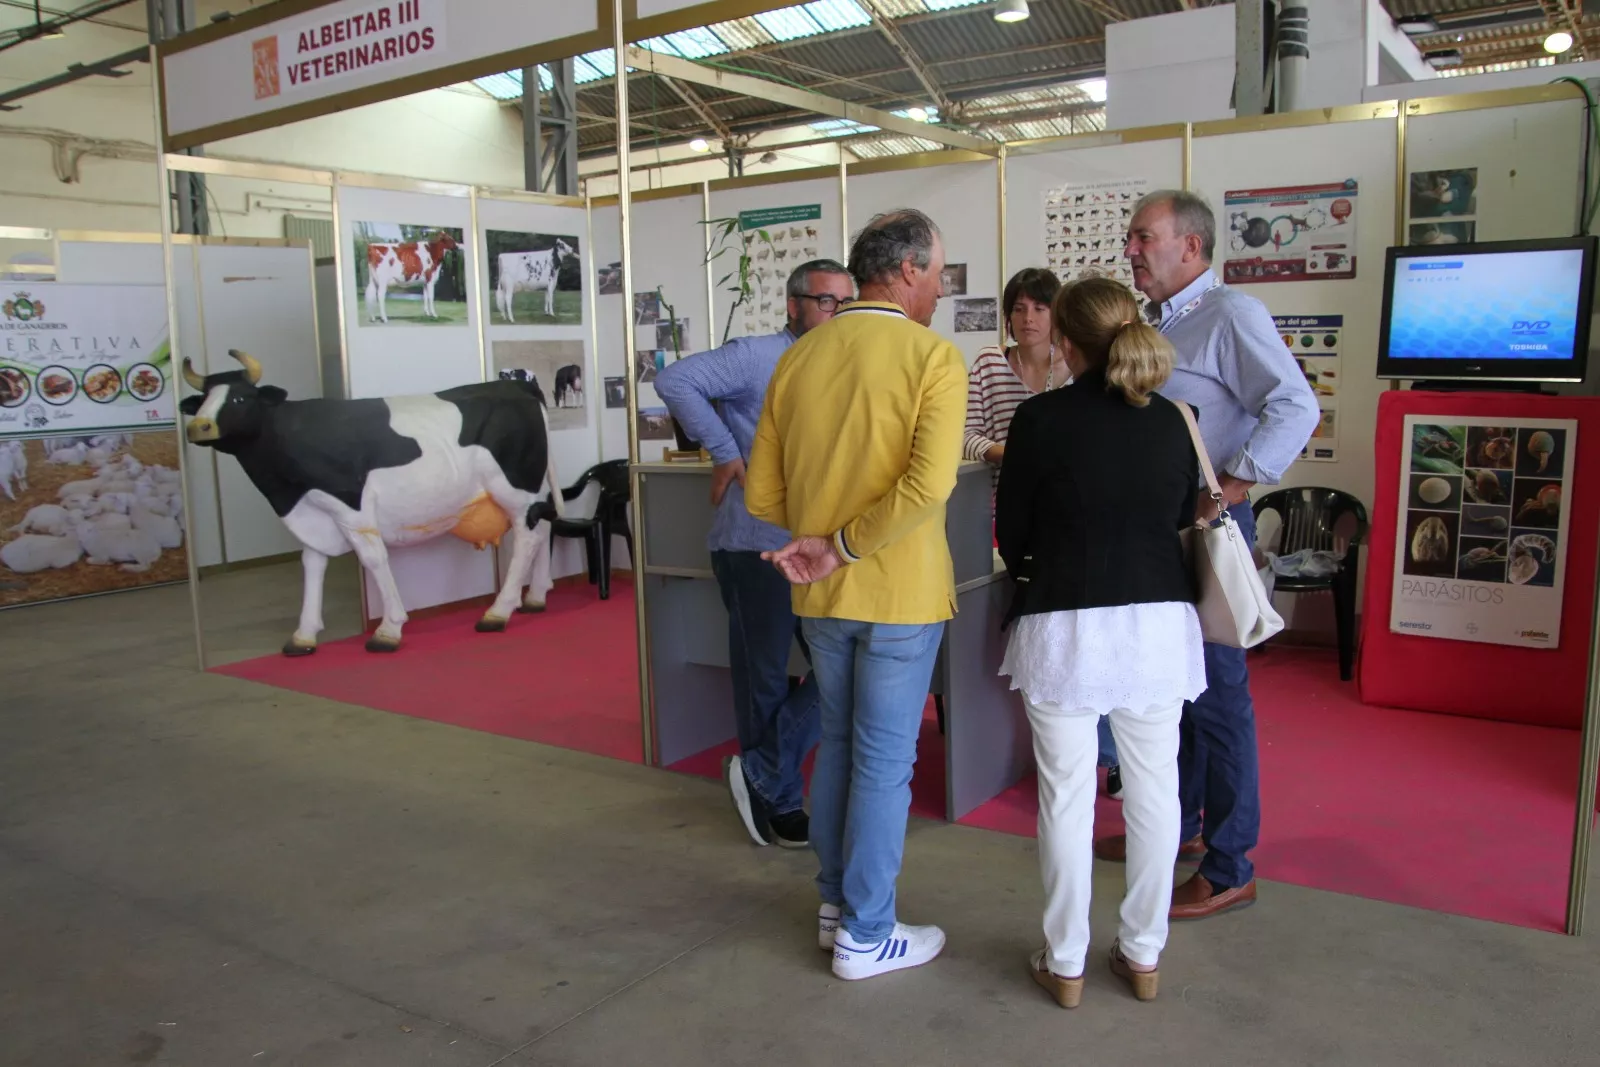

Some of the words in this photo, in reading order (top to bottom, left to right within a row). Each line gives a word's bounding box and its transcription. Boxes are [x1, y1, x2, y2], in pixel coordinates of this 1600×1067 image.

[297, 7, 391, 53] ALBEITAR
[398, 0, 420, 24] III
[287, 27, 434, 85] VETERINARIOS
[1301, 318, 1318, 326] gato
[1512, 320, 1551, 330] DVD
[1509, 343, 1548, 351] TOSHIBA
[1402, 579, 1504, 605] PARÁSITOS
